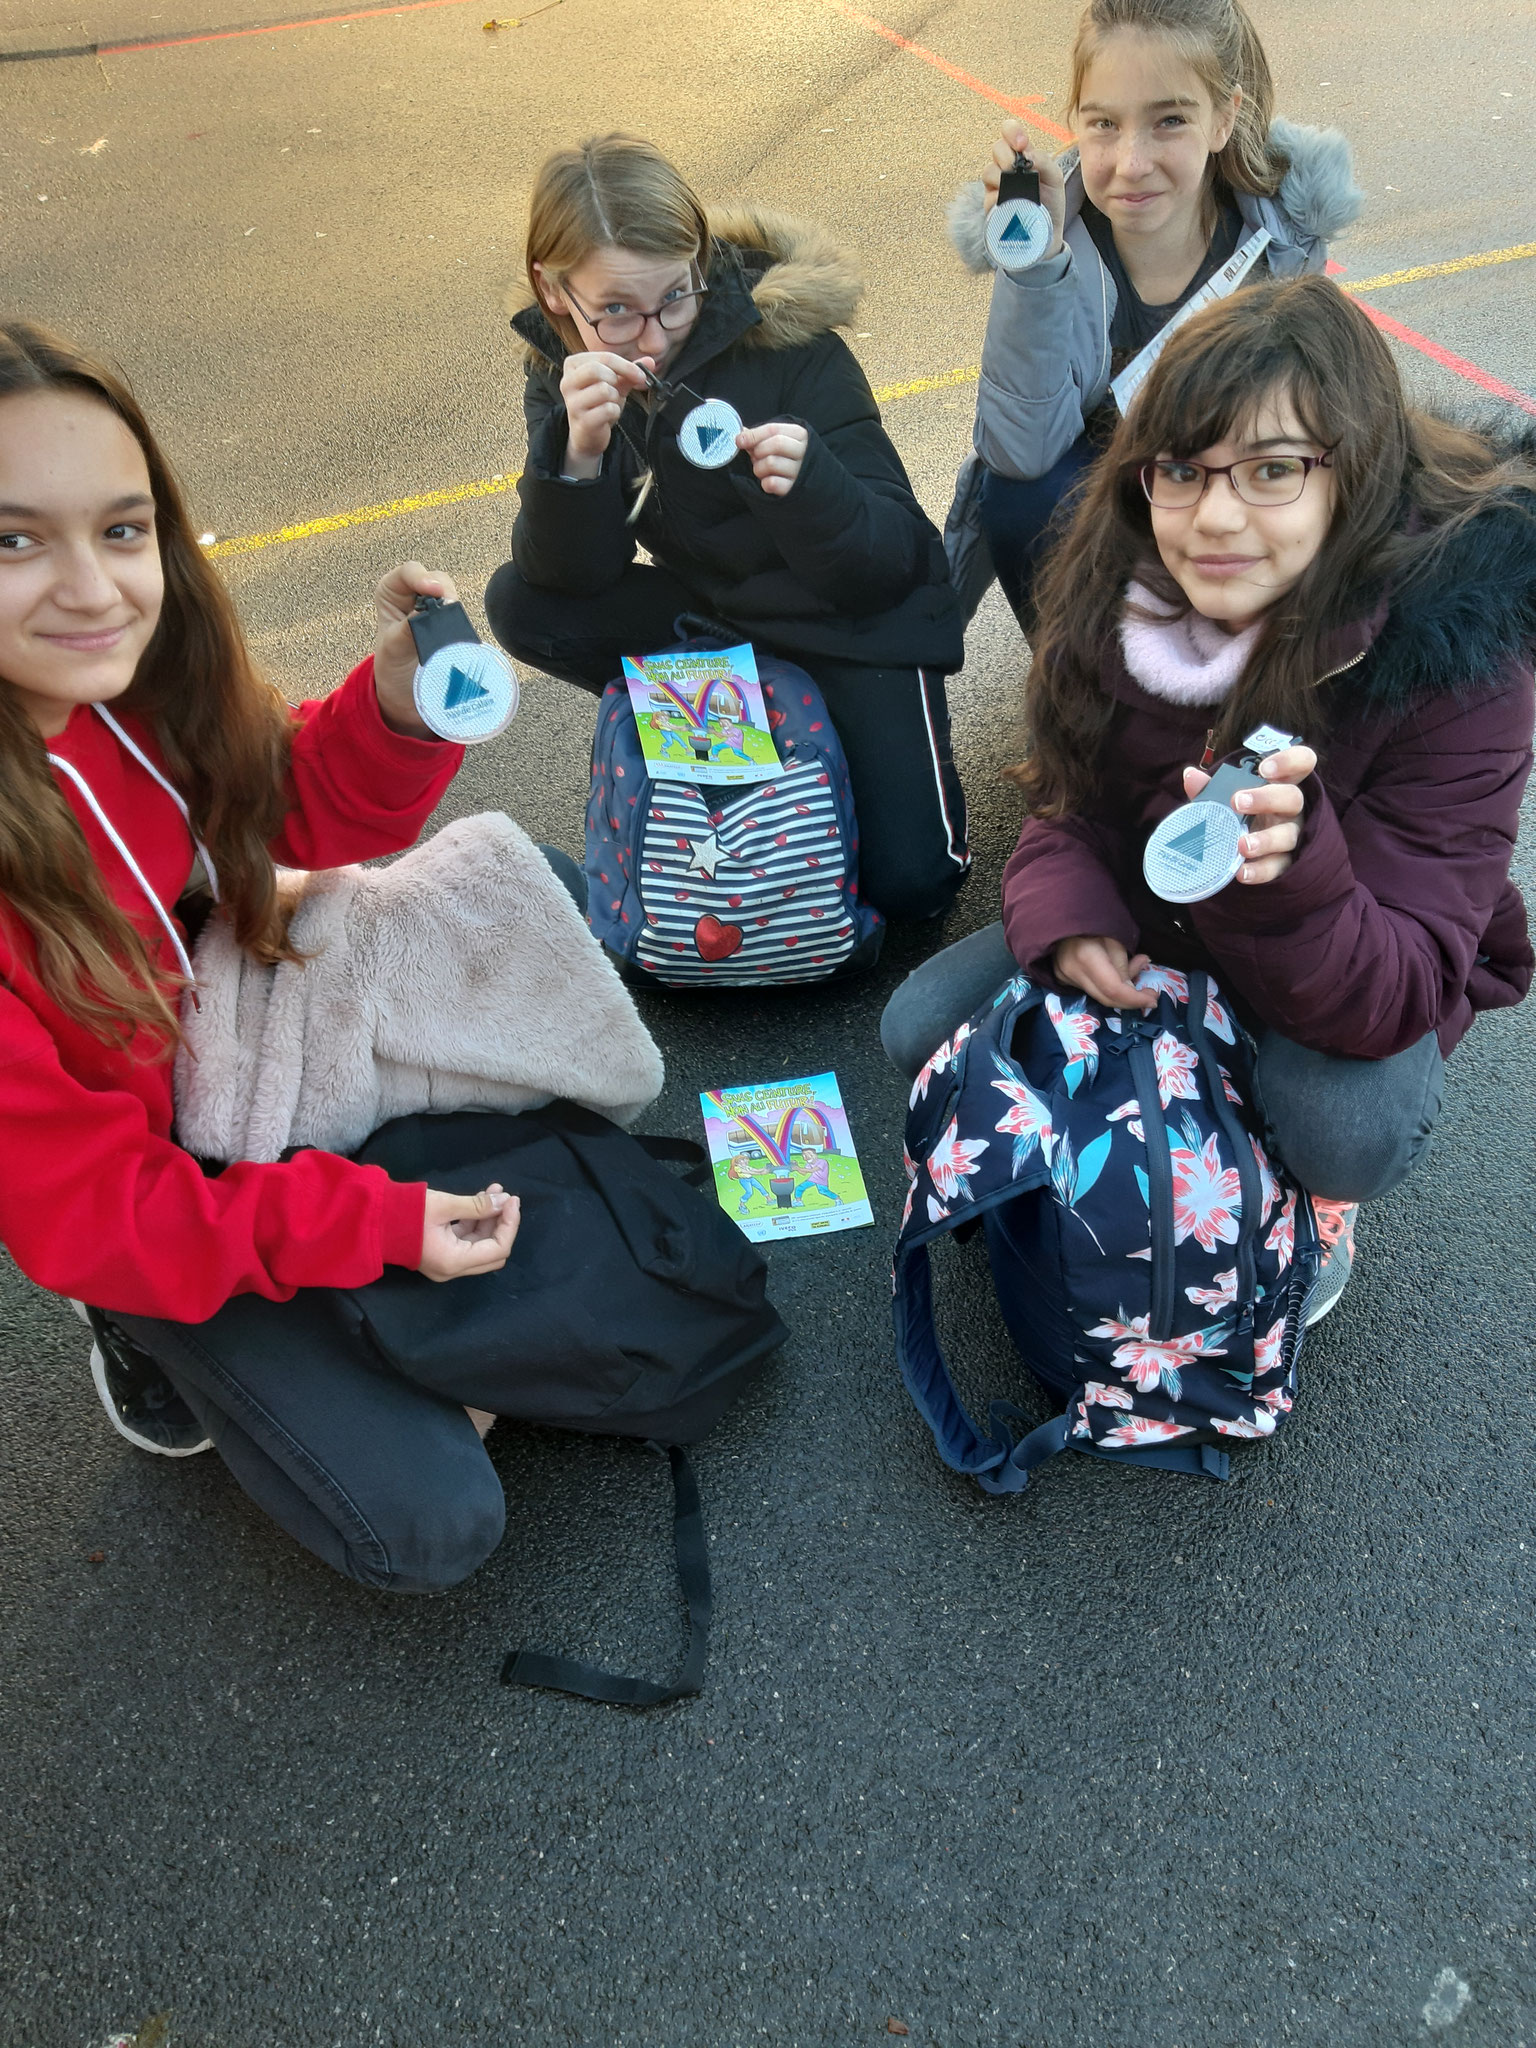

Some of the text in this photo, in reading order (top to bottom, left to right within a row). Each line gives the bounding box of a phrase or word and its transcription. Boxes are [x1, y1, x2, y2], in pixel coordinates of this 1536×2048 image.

[721, 1091, 753, 1106] SANS
[723, 1103, 749, 1117] NON
[750, 1101, 766, 1114] AU
